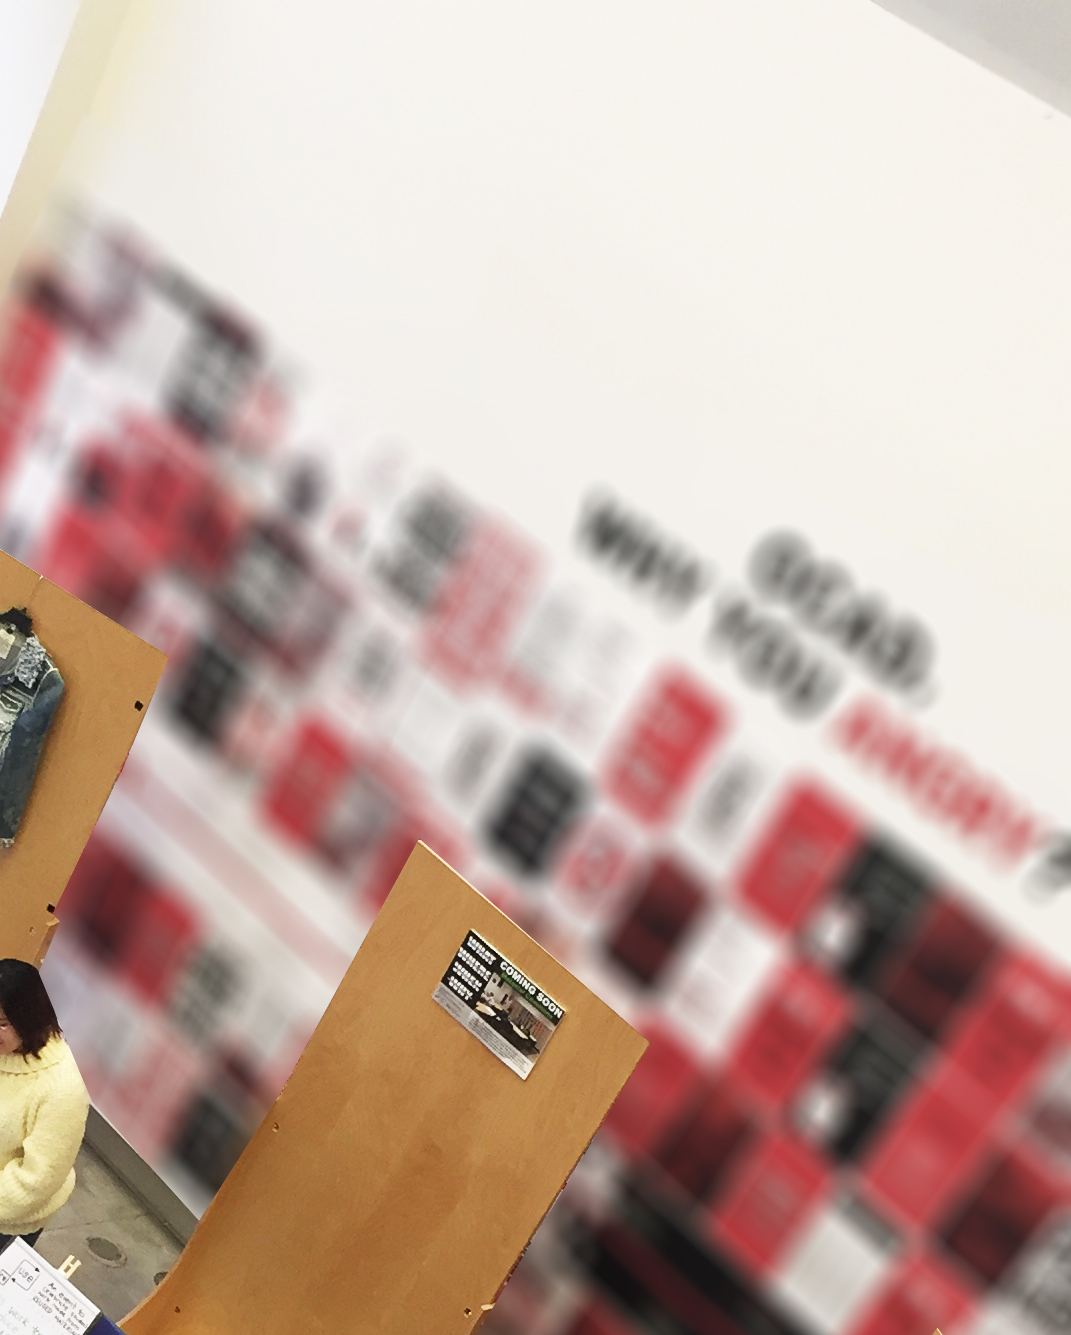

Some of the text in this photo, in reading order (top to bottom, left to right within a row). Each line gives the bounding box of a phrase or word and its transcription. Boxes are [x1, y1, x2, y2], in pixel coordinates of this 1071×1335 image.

[499, 961, 563, 1019] COMING SOON
[18, 1266, 34, 1282] use
[47, 1281, 86, 1318] An event to
[8, 1306, 29, 1326] work
